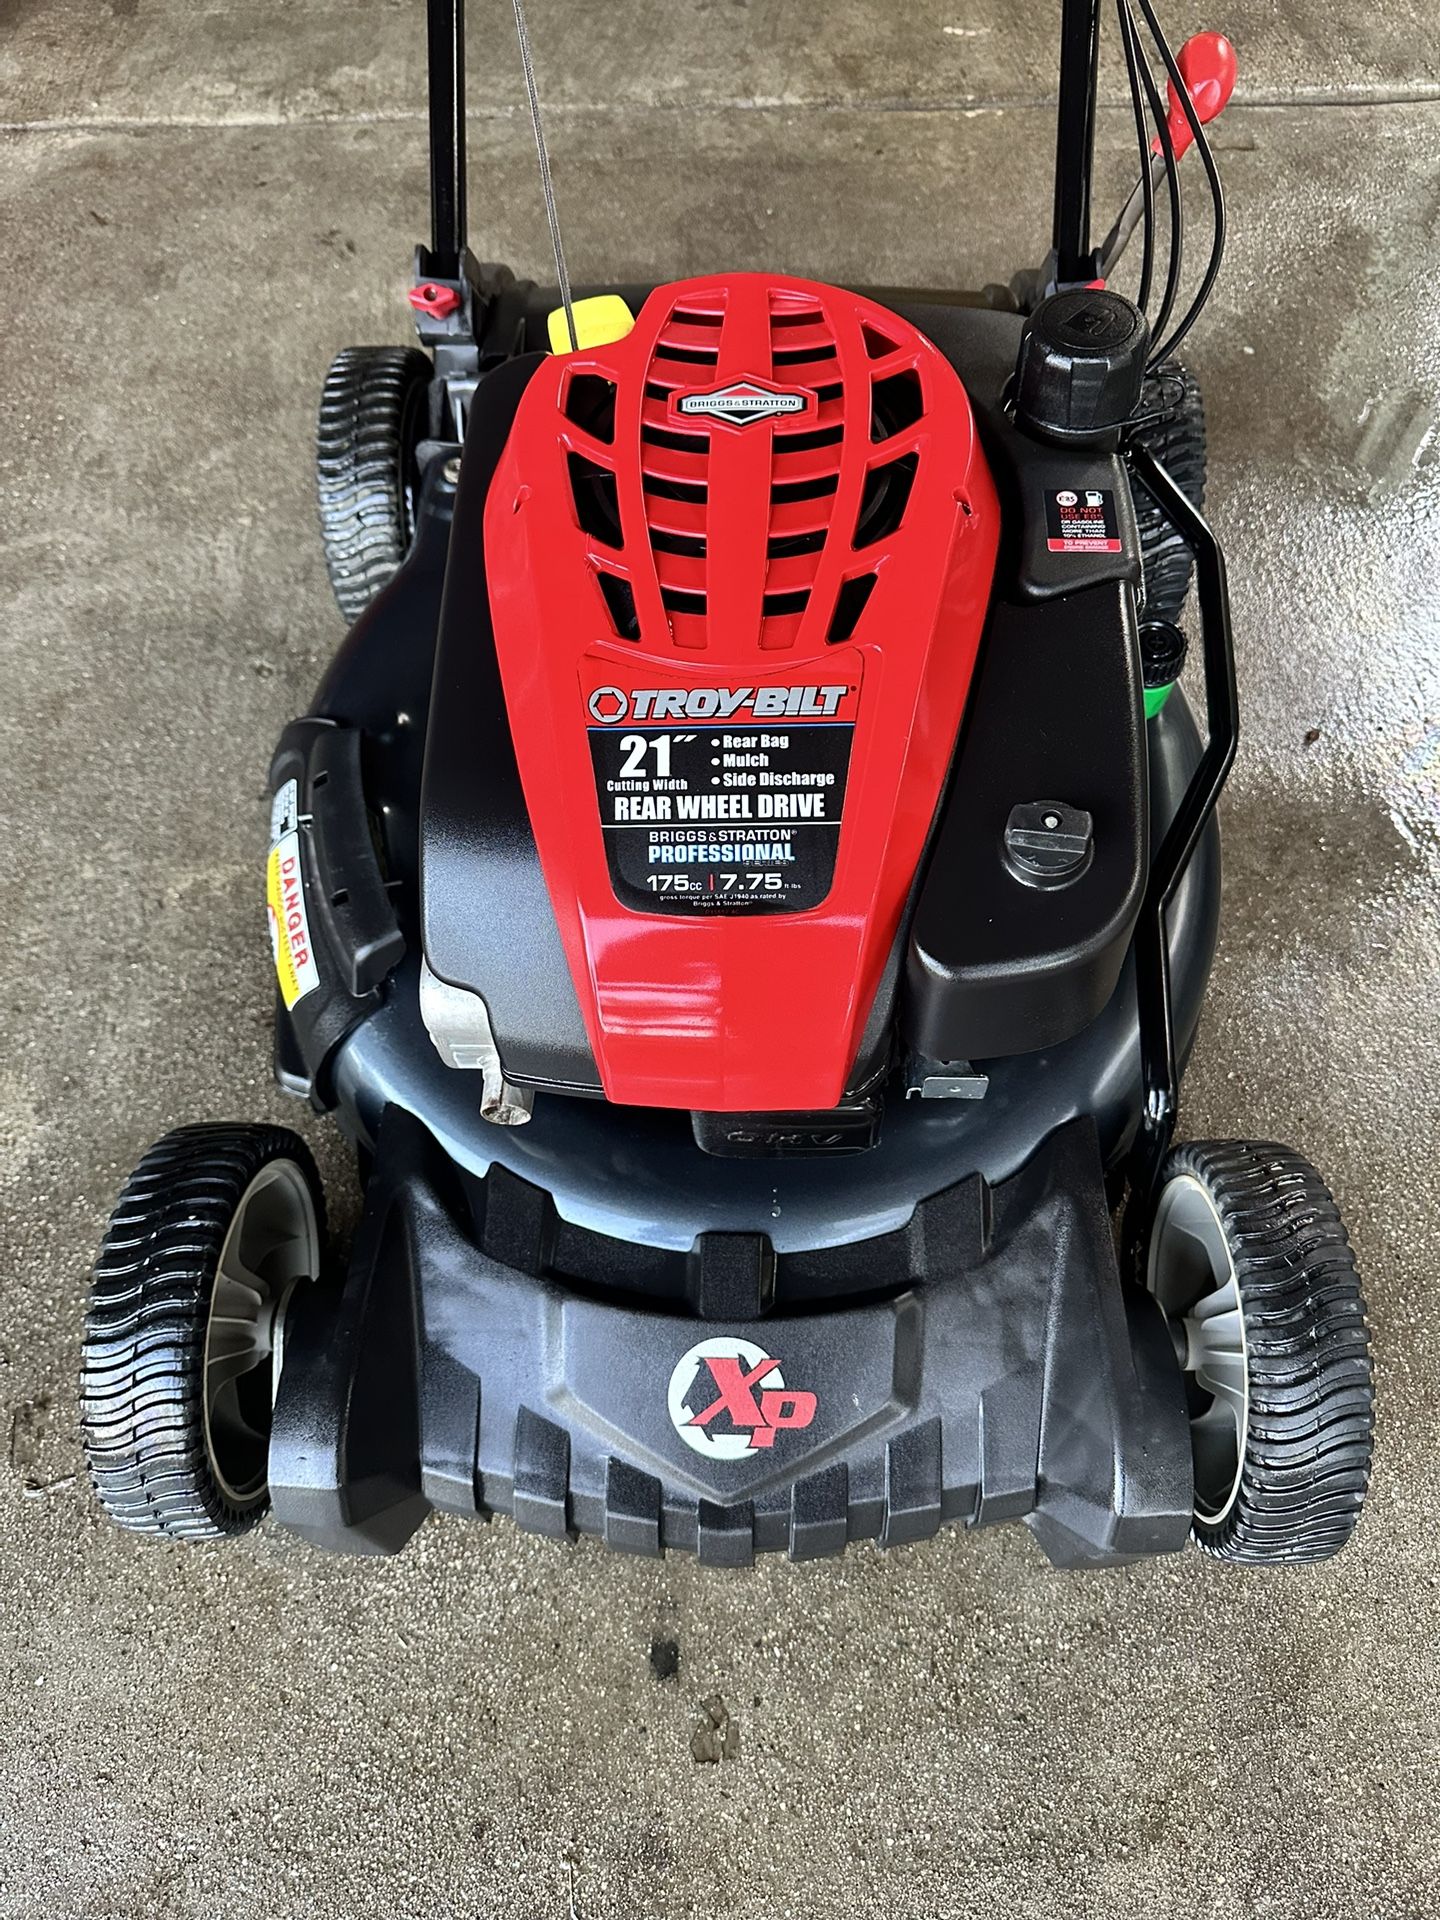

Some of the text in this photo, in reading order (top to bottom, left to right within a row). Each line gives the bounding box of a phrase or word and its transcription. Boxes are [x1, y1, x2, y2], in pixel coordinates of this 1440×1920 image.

[630, 685, 848, 720] TROY-BILT
[722, 735, 789, 749] Rear Bag
[722, 753, 769, 768] Mulch
[606, 779, 688, 792] Cutting Width
[722, 772, 835, 788] Side Discharge
[614, 793, 826, 821] REAR WHEEL DRIVE
[648, 843, 796, 863] PROFESSIONAL
[719, 872, 783, 891] 7.75
[679, 893, 700, 901] torque
[759, 892, 777, 900] rated
[778, 892, 787, 900] by
[281, 856, 308, 969] DANGER
